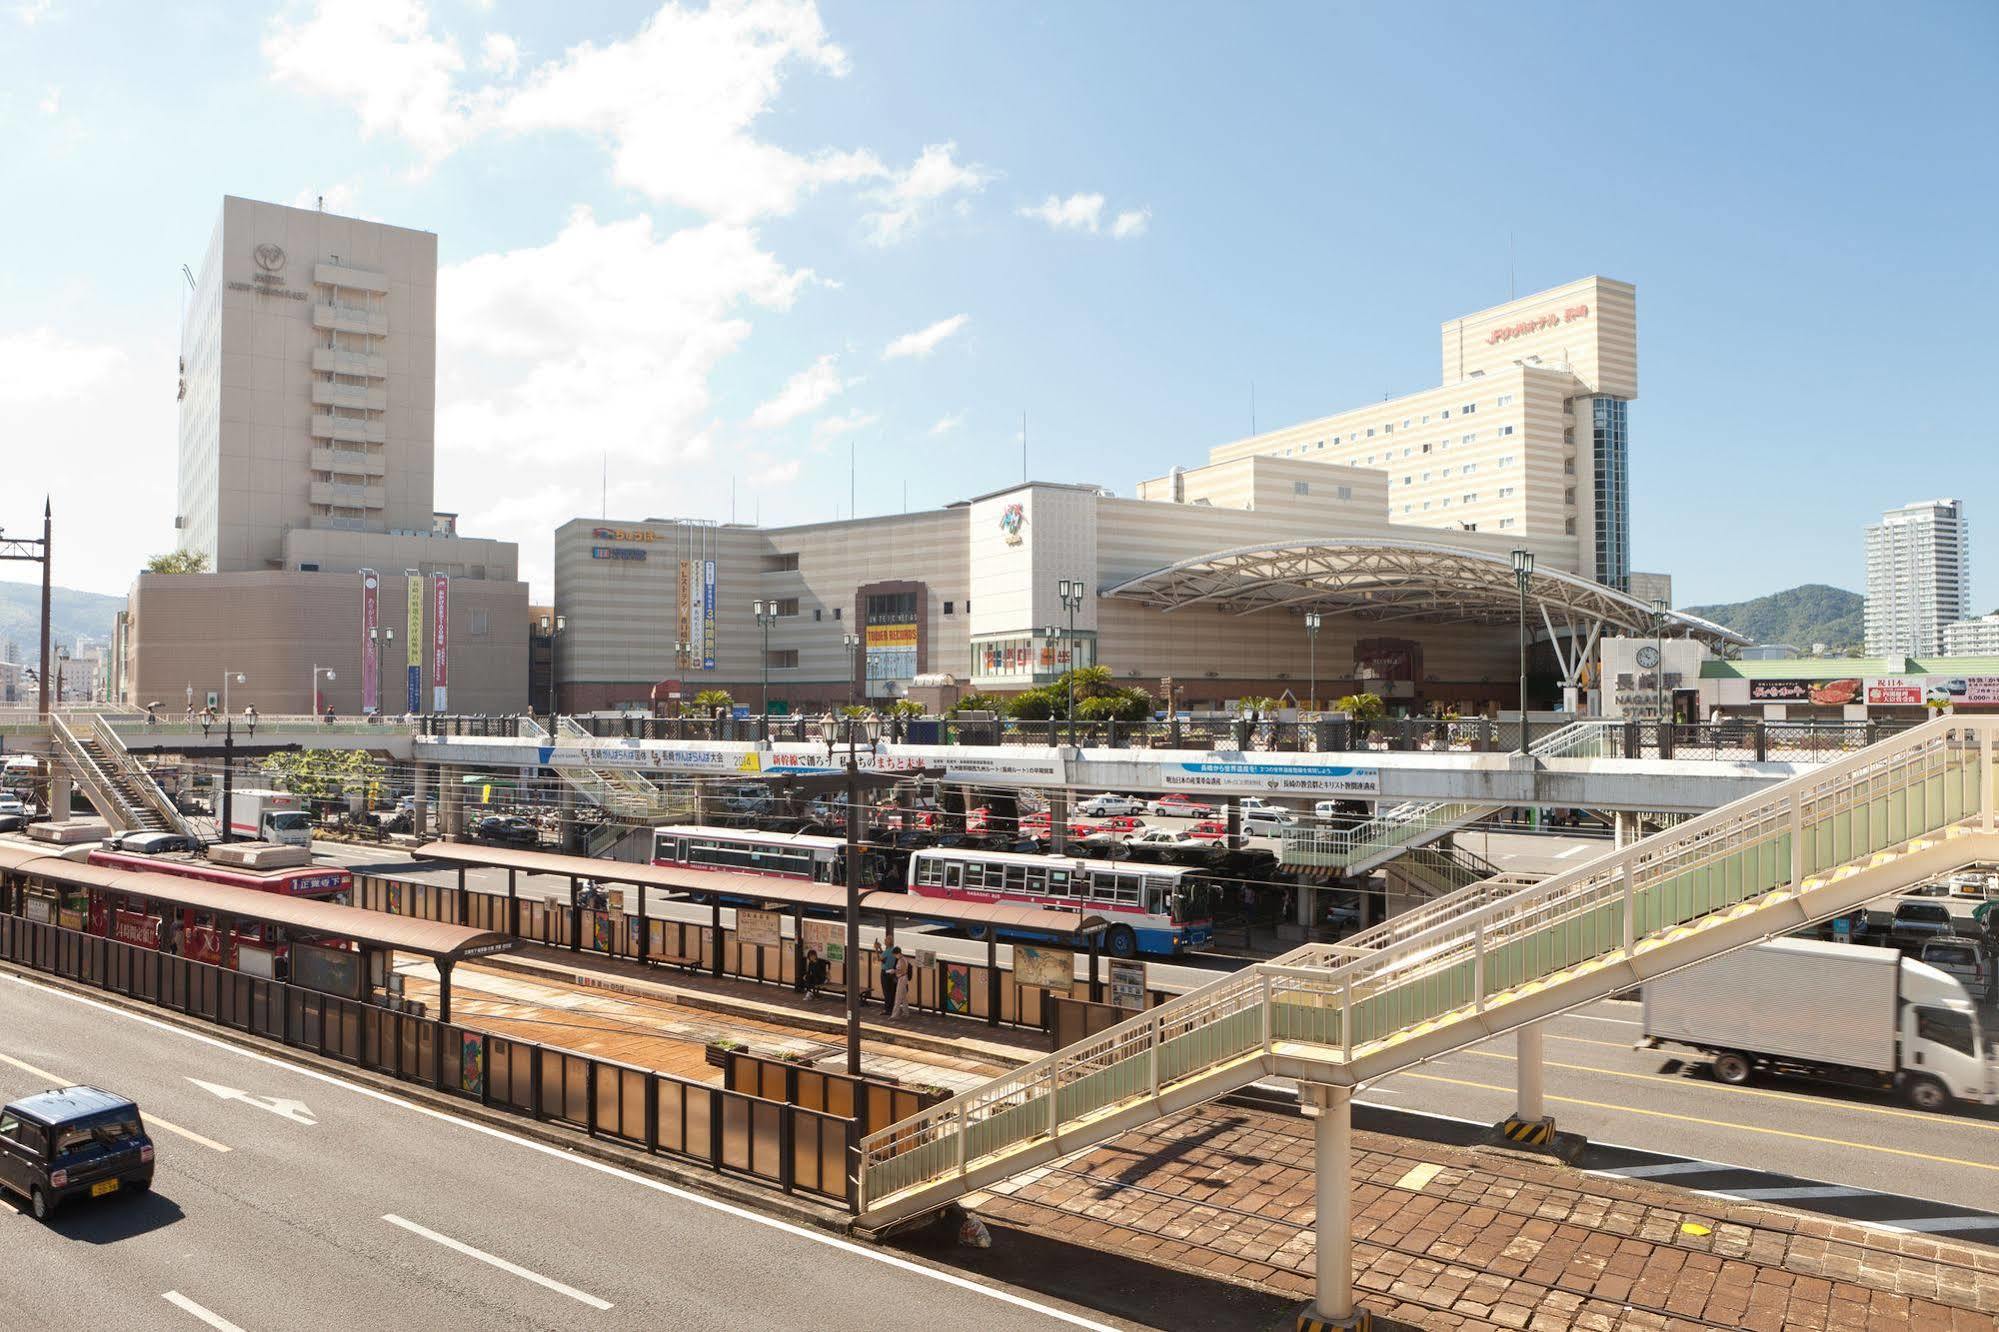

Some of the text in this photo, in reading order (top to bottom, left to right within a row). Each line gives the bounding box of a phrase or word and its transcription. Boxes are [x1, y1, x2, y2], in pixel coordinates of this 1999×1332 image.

[868, 629, 918, 643] TOWER RECORDS
[1057, 650, 1071, 658] ABC
[734, 755, 751, 767] 2014
